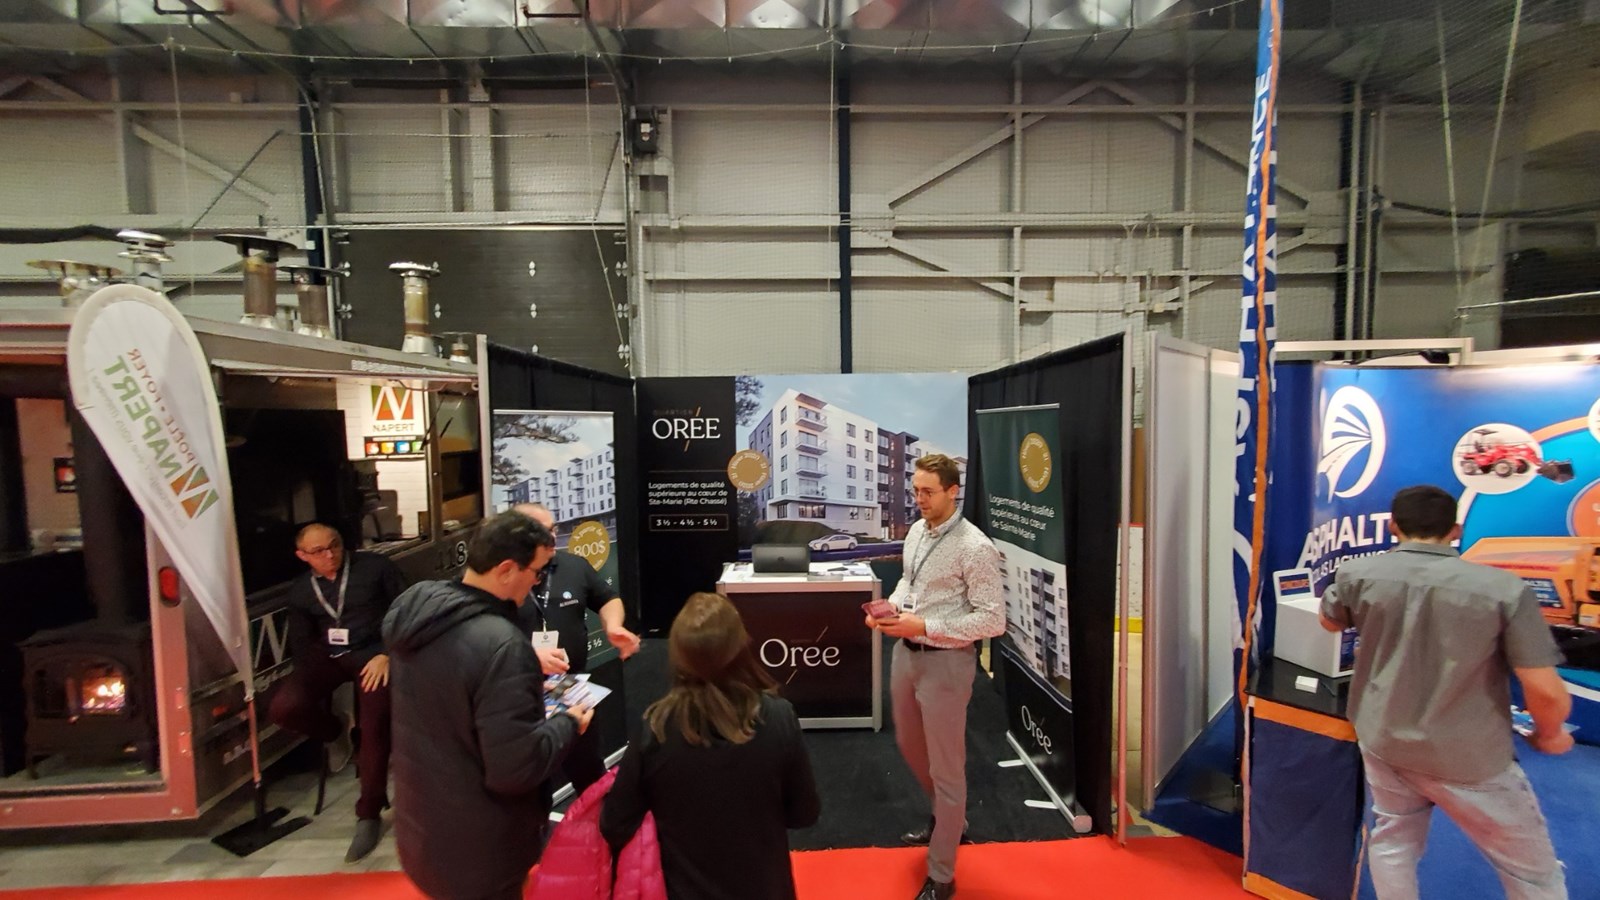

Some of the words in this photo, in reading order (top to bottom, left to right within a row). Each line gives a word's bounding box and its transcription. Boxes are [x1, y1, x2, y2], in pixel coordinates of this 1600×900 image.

[372, 423, 415, 432] NAPERT
[648, 482, 689, 490] Logements
[700, 481, 725, 490] qualité
[648, 489, 686, 498] supérieure
[684, 498, 698, 506] (Rte
[700, 498, 728, 506] Chassé)
[989, 493, 1021, 510] Logements
[1021, 501, 1031, 512] de
[1031, 503, 1055, 518] qualité
[990, 507, 1021, 522] supérieure
[1020, 515, 1029, 525] au
[1029, 517, 1047, 531] cœur
[992, 519, 999, 529] de
[999, 521, 1036, 541] Sainte-Marie
[1295, 512, 1398, 570] ASPHALT
